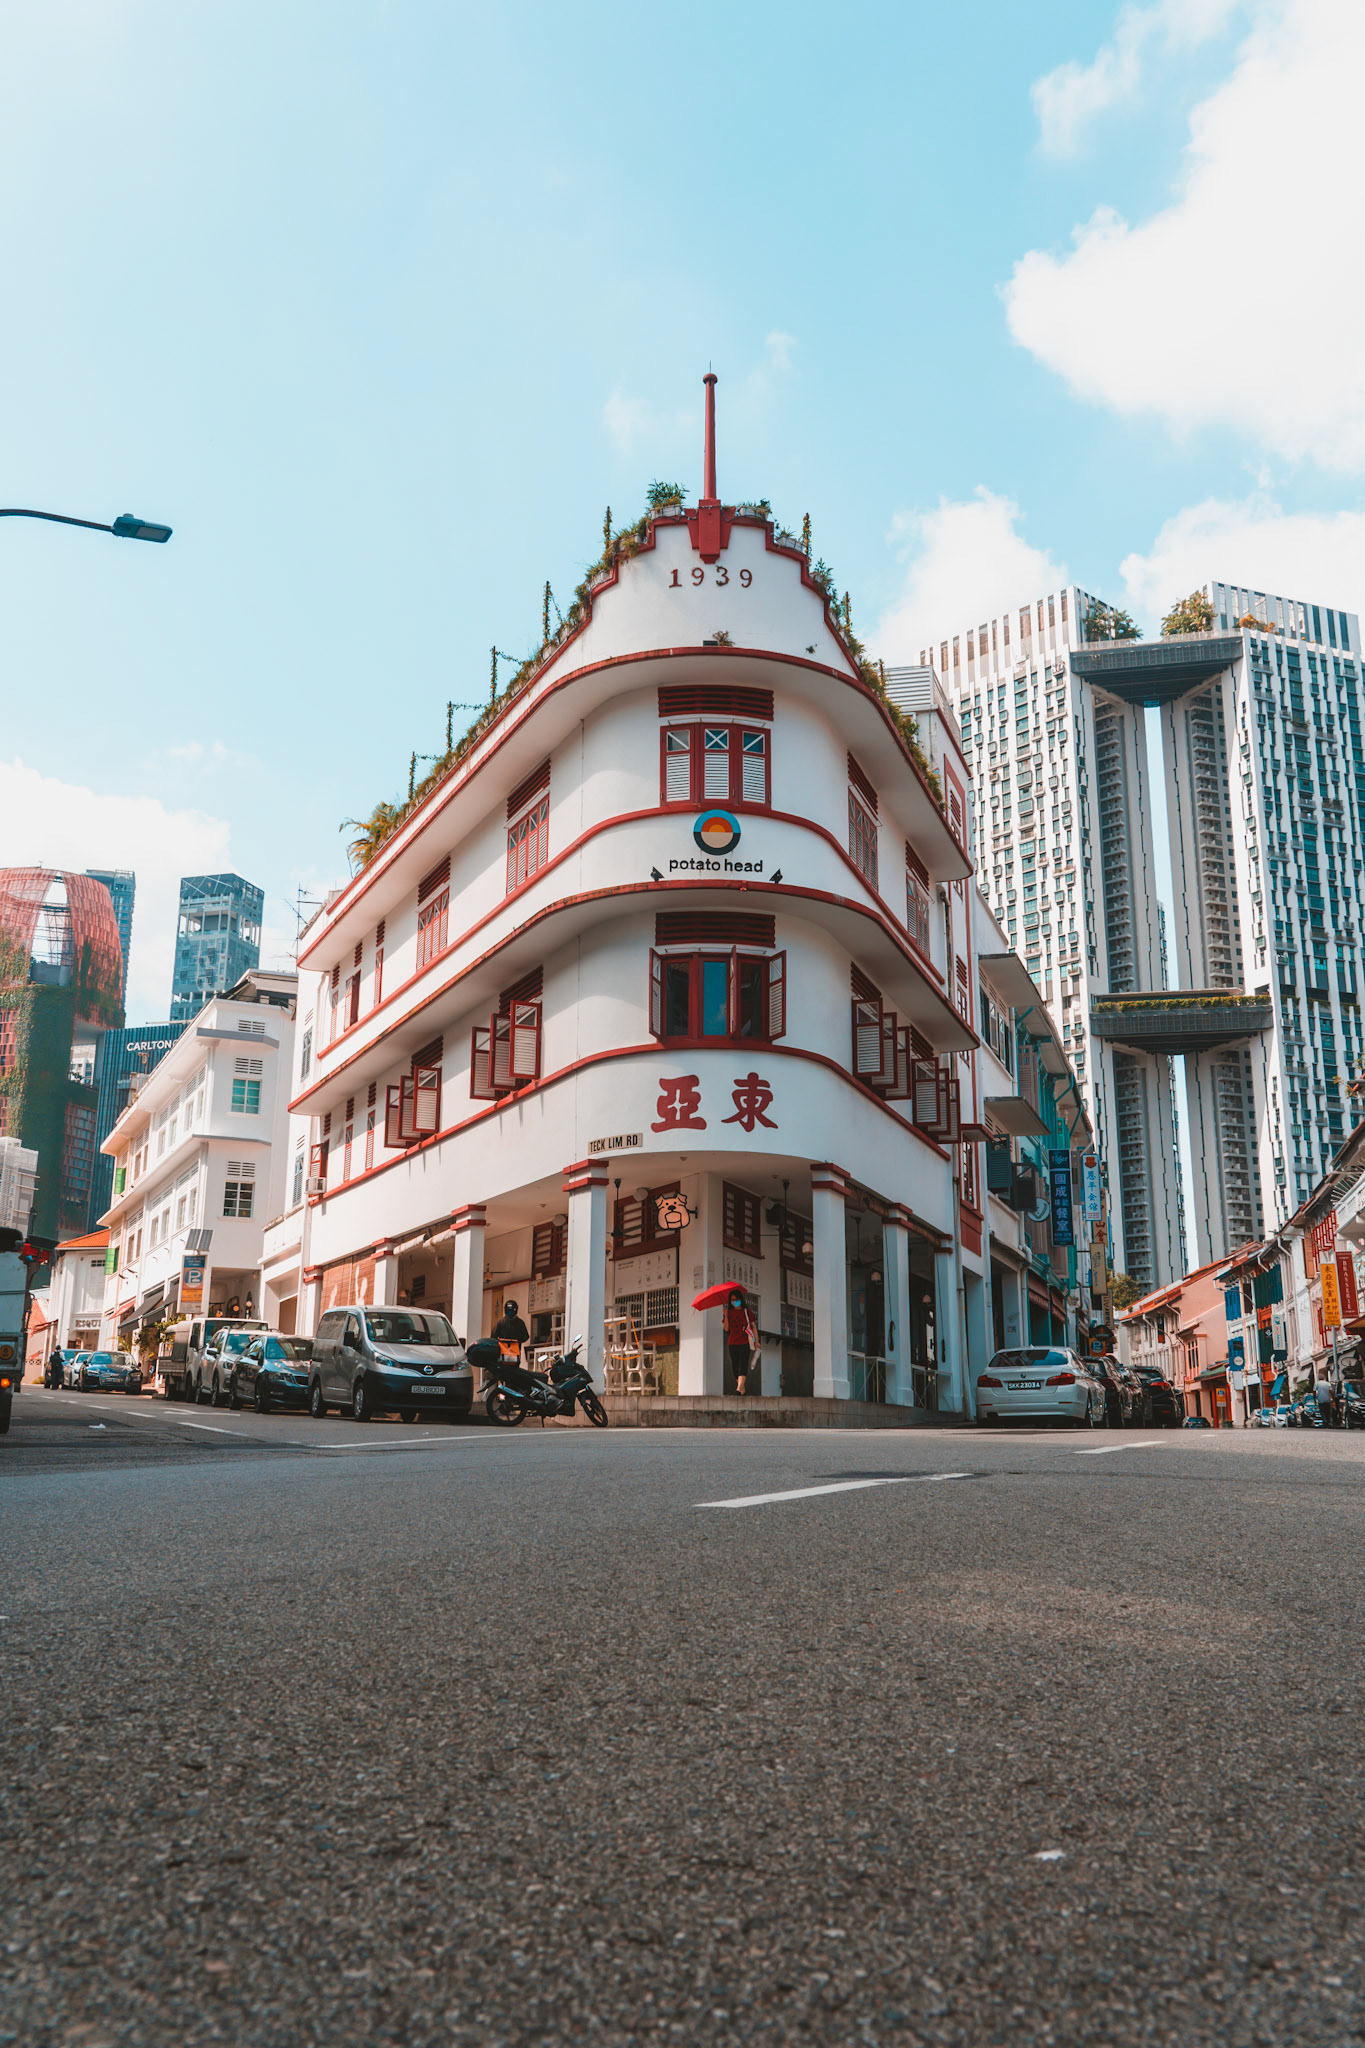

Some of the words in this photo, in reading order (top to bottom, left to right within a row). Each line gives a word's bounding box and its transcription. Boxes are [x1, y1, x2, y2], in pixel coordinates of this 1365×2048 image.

[669, 566, 753, 589] 1939
[669, 858, 721, 873] potato
[724, 858, 763, 873] head
[126, 1040, 172, 1051] CARLTON
[590, 1138, 606, 1153] TECK
[608, 1136, 623, 1149] LIM
[626, 1134, 638, 1147] RD
